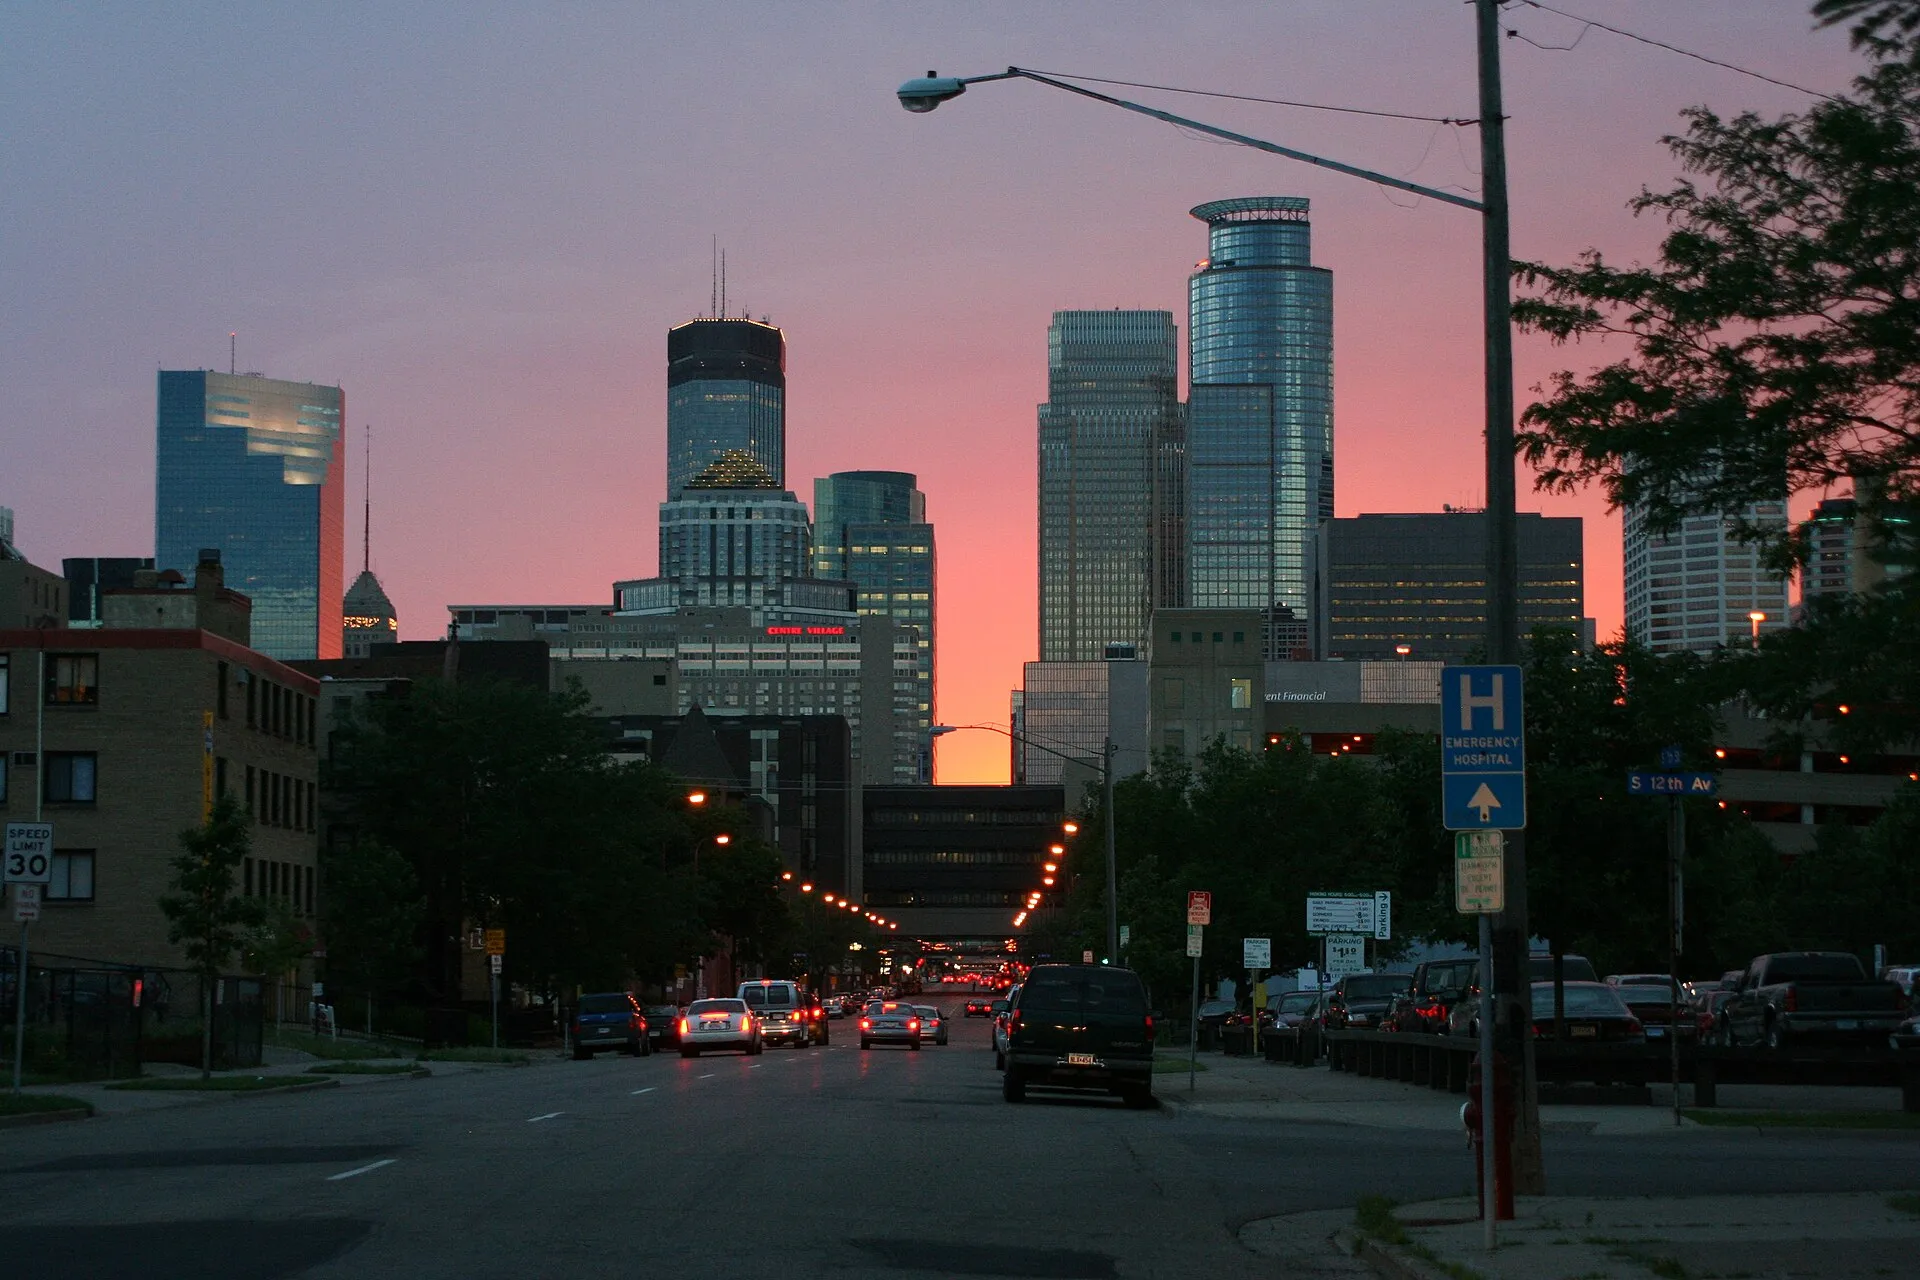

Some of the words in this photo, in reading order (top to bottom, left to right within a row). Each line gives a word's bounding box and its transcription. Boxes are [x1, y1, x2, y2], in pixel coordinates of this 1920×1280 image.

[767, 626, 802, 635] CENTRE
[807, 626, 844, 635] VILLAGE
[1283, 690, 1327, 701] Financial
[1460, 674, 1504, 731] H
[1445, 737, 1520, 749] EMERGENCY
[1454, 753, 1513, 766] HOSPITAL
[1631, 776, 1641, 790] S
[1650, 776, 1683, 791] 12th
[1691, 776, 1712, 791] Av
[9, 829, 50, 839] SPEED
[12, 841, 45, 851] LIMIT
[9, 854, 47, 876] 30
[1378, 903, 1389, 939] Parking
